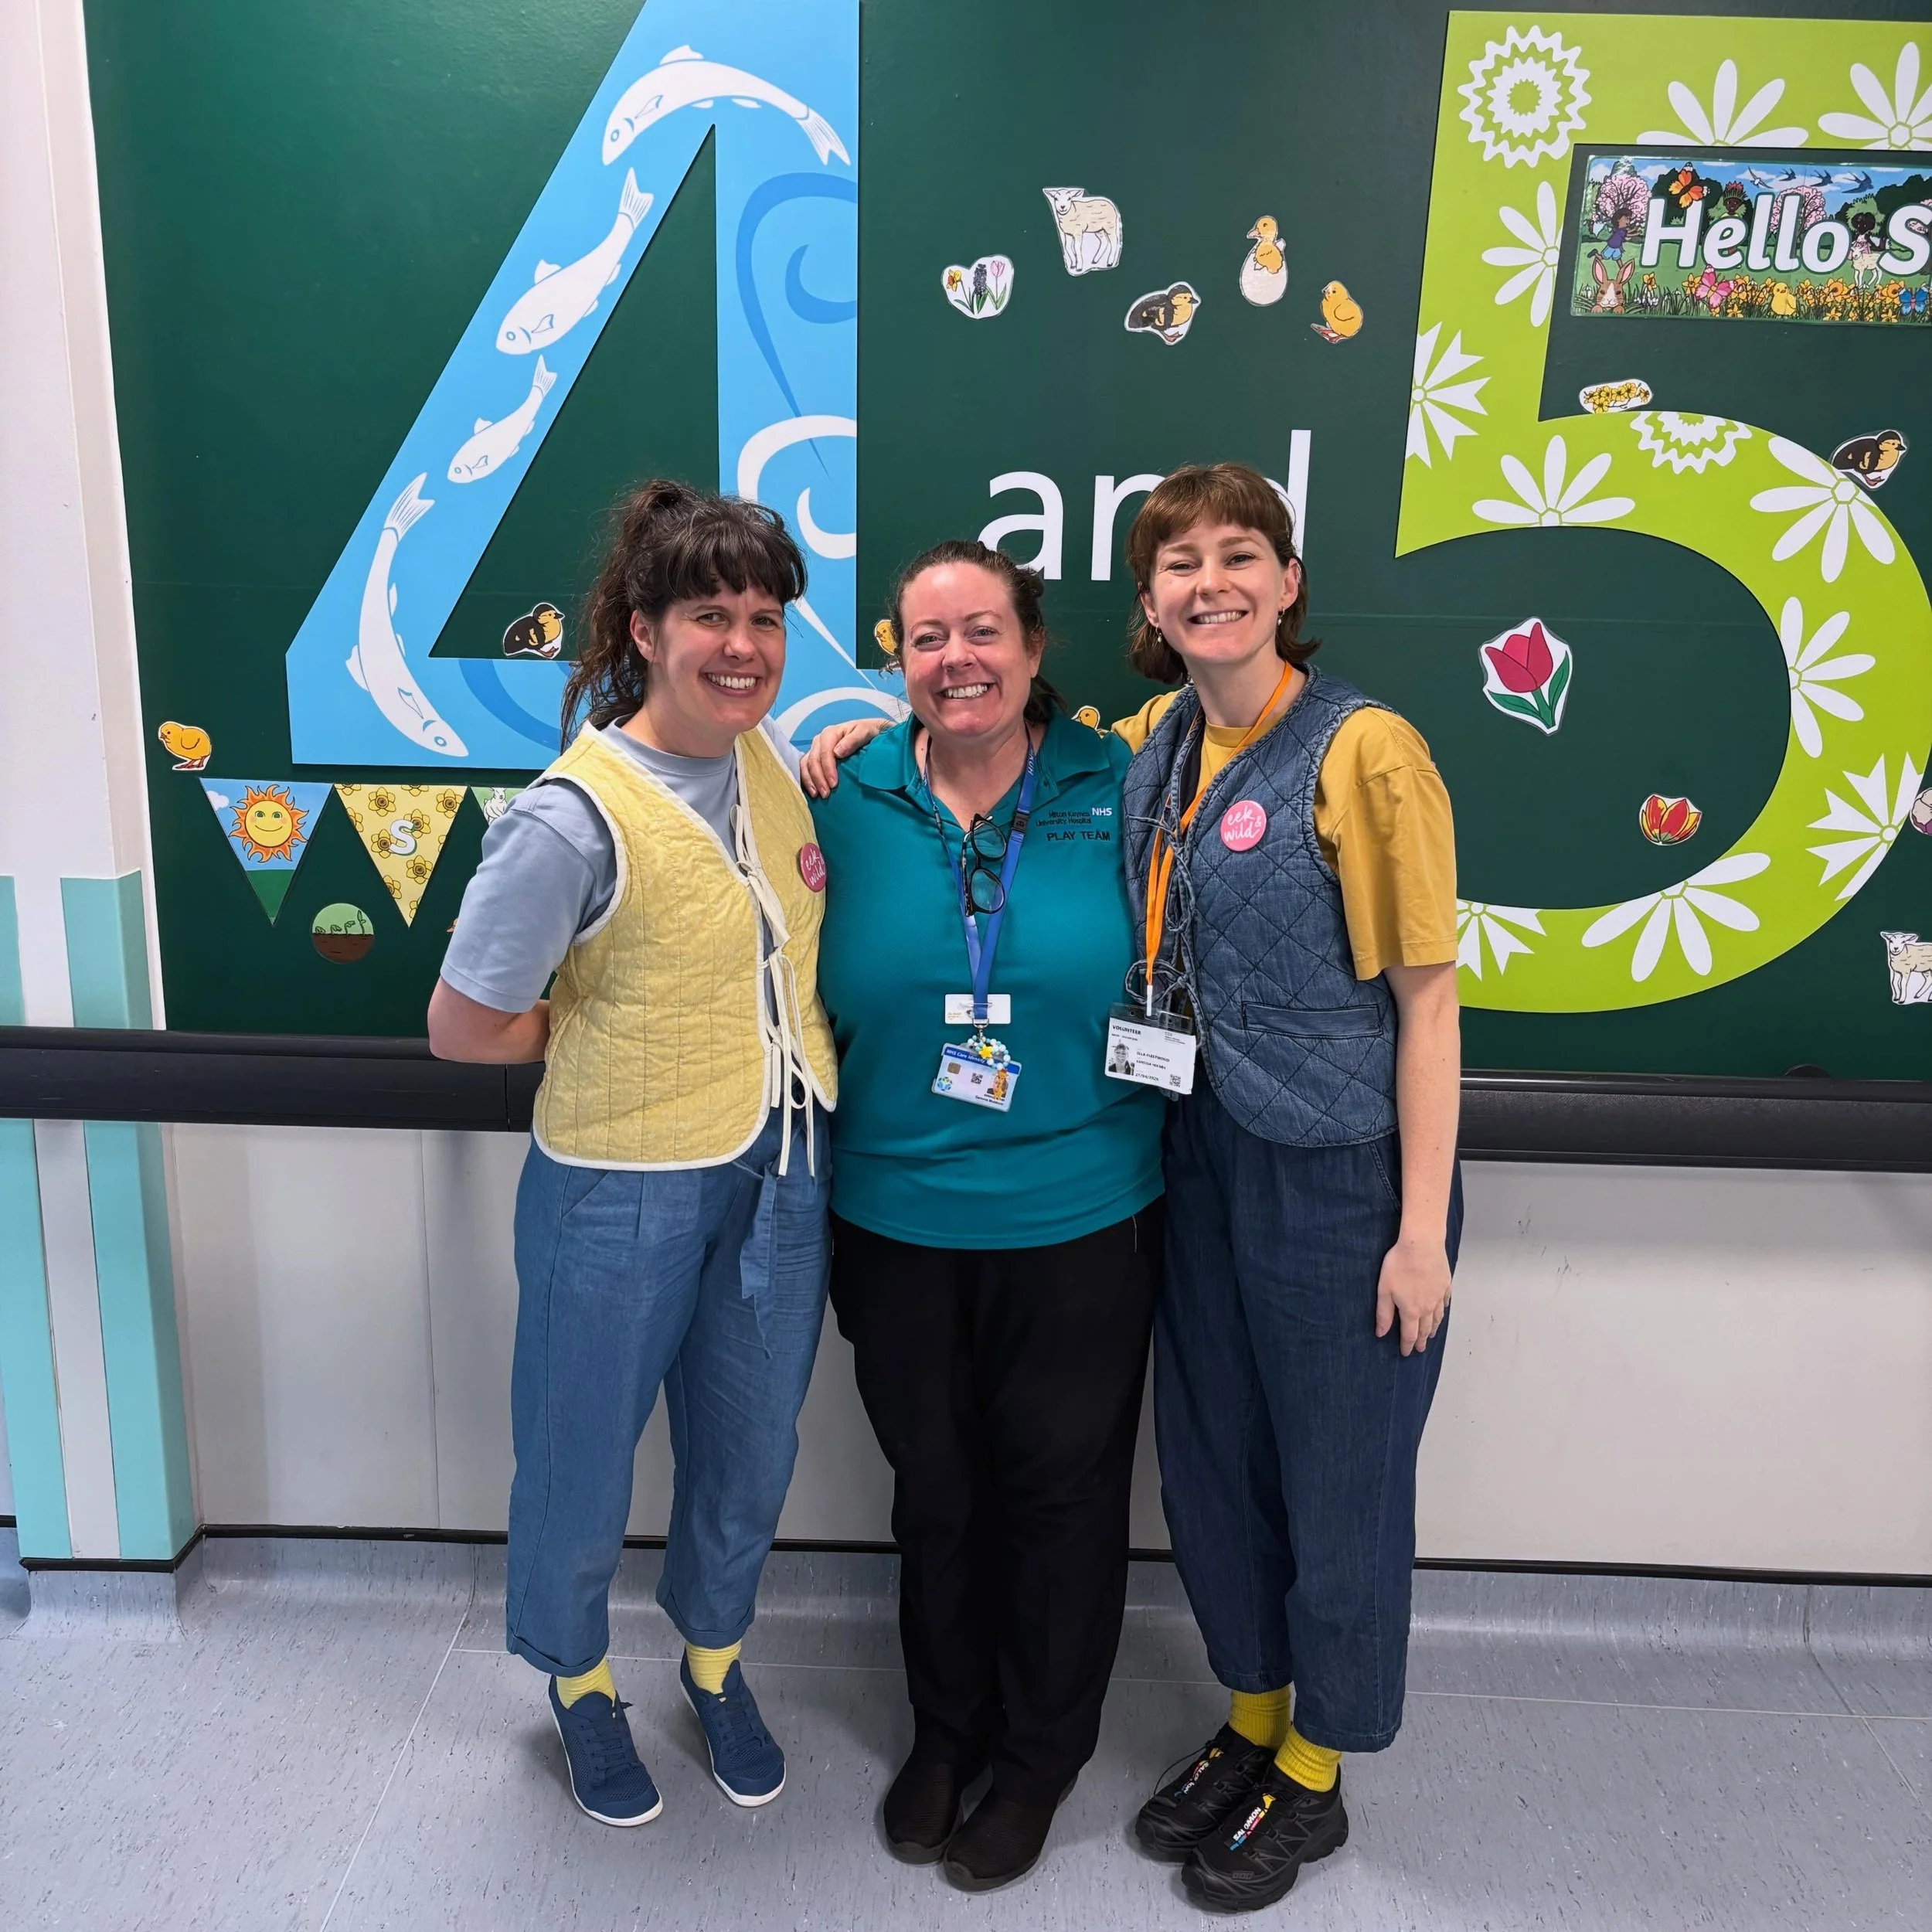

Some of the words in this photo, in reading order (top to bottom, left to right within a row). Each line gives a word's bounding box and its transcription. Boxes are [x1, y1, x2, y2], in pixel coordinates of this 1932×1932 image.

[1640, 192, 1851, 273] Hello
[286, 0, 910, 768] 4
[1396, 8, 1932, 1014] 5
[1091, 807, 1113, 816] NHS
[1227, 805, 1255, 825] eek
[1036, 818, 1066, 827] University
[1224, 822, 1260, 842] wild
[389, 819, 418, 855] S
[1046, 830, 1076, 842] PLAY
[1080, 829, 1111, 842] TEAM
[1113, 1025, 1141, 1035] VOLUNTEER
[1233, 1807, 1262, 1841] SALOMON
